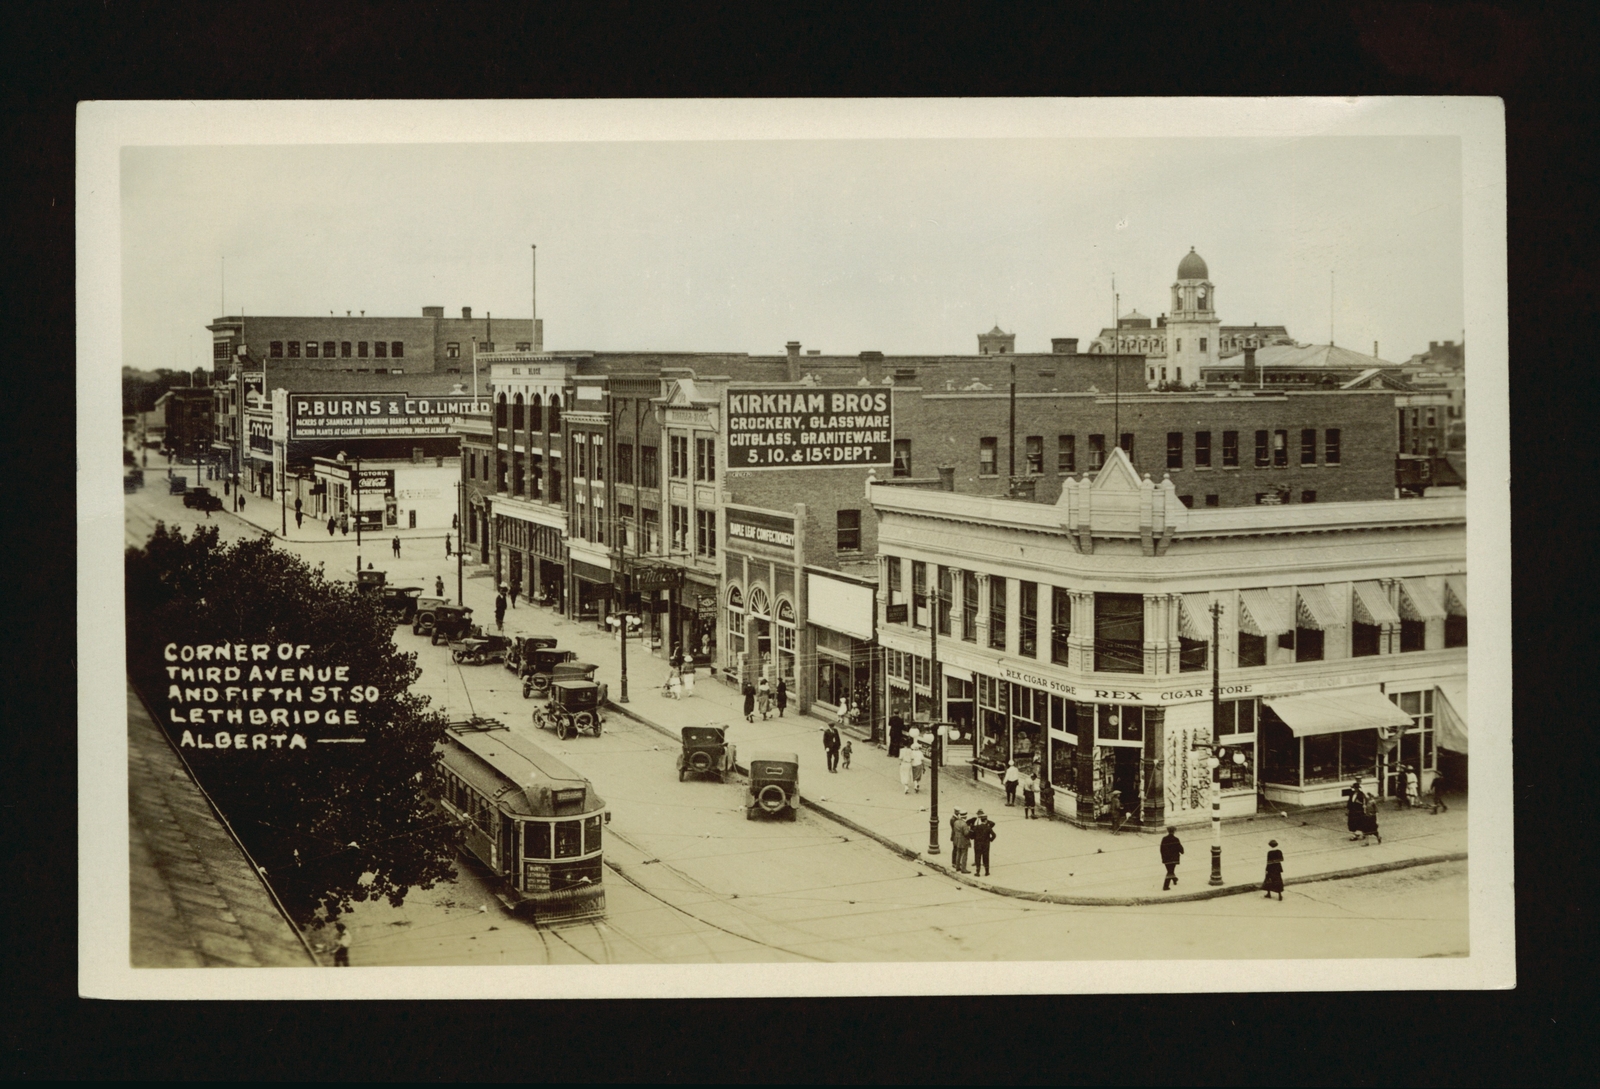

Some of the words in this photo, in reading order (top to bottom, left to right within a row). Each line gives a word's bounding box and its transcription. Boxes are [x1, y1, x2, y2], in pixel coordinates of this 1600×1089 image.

[297, 401, 380, 415] P.BURNS
[388, 401, 399, 414] &
[404, 400, 434, 414] CO.
[729, 393, 826, 414] KIRKHAM
[831, 393, 888, 413] BROS
[730, 417, 805, 430] CROCKERY,
[809, 415, 891, 429] GLASSWARE
[730, 433, 797, 446] CUTGLASS,
[791, 450, 804, 462] &
[833, 446, 877, 461] DEPT.
[730, 522, 744, 536] MAPLE
[744, 525, 756, 539] LEAF
[756, 527, 794, 546] CONFECTIONERY
[1006, 669, 1022, 680] REX
[1023, 674, 1048, 688] CIGAR
[1050, 681, 1077, 696] STORE
[1094, 690, 1143, 700] REX
[1160, 690, 1203, 701] CIGAR
